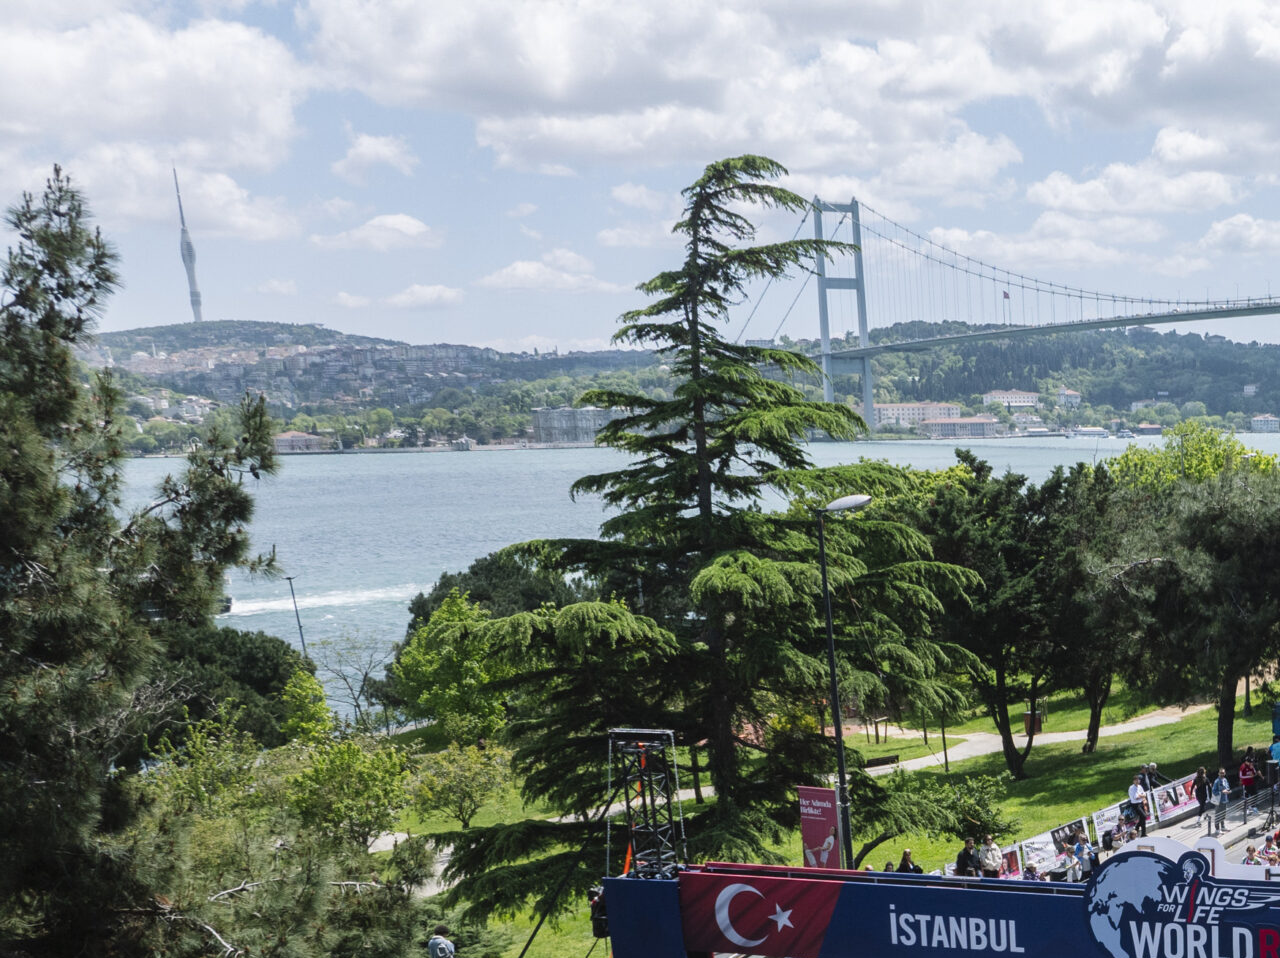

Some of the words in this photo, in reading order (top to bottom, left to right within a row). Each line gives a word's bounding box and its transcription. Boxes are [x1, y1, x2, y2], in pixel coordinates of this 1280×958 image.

[1161, 883, 1249, 907] WINGS
[1157, 903, 1176, 913] FOR
[1173, 905, 1224, 925] LIFE
[888, 904, 1025, 953] İSTANBUL
